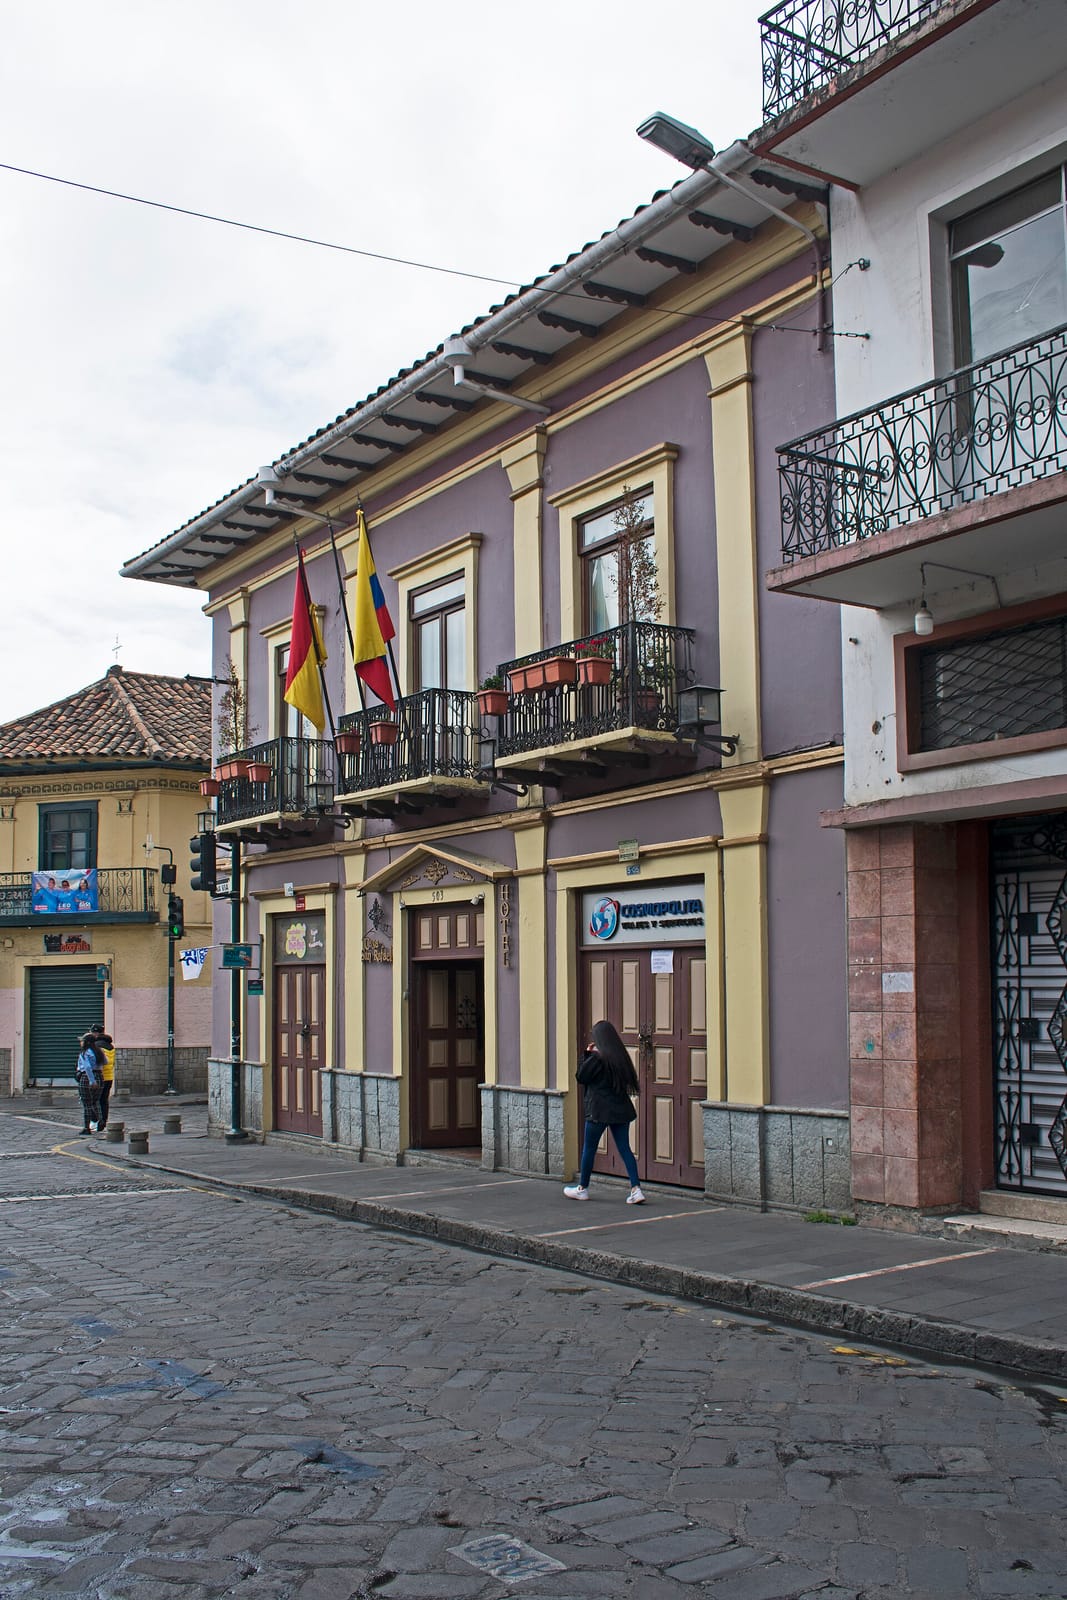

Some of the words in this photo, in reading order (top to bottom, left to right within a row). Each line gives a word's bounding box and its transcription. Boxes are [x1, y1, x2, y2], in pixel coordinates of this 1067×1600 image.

[432, 889, 444, 903] 503
[621, 899, 704, 918] COSMOPOLITA
[500, 884, 511, 967] HOTEL
[621, 921, 650, 930] VIAJES
[659, 918, 704, 928] SERVICIOS
